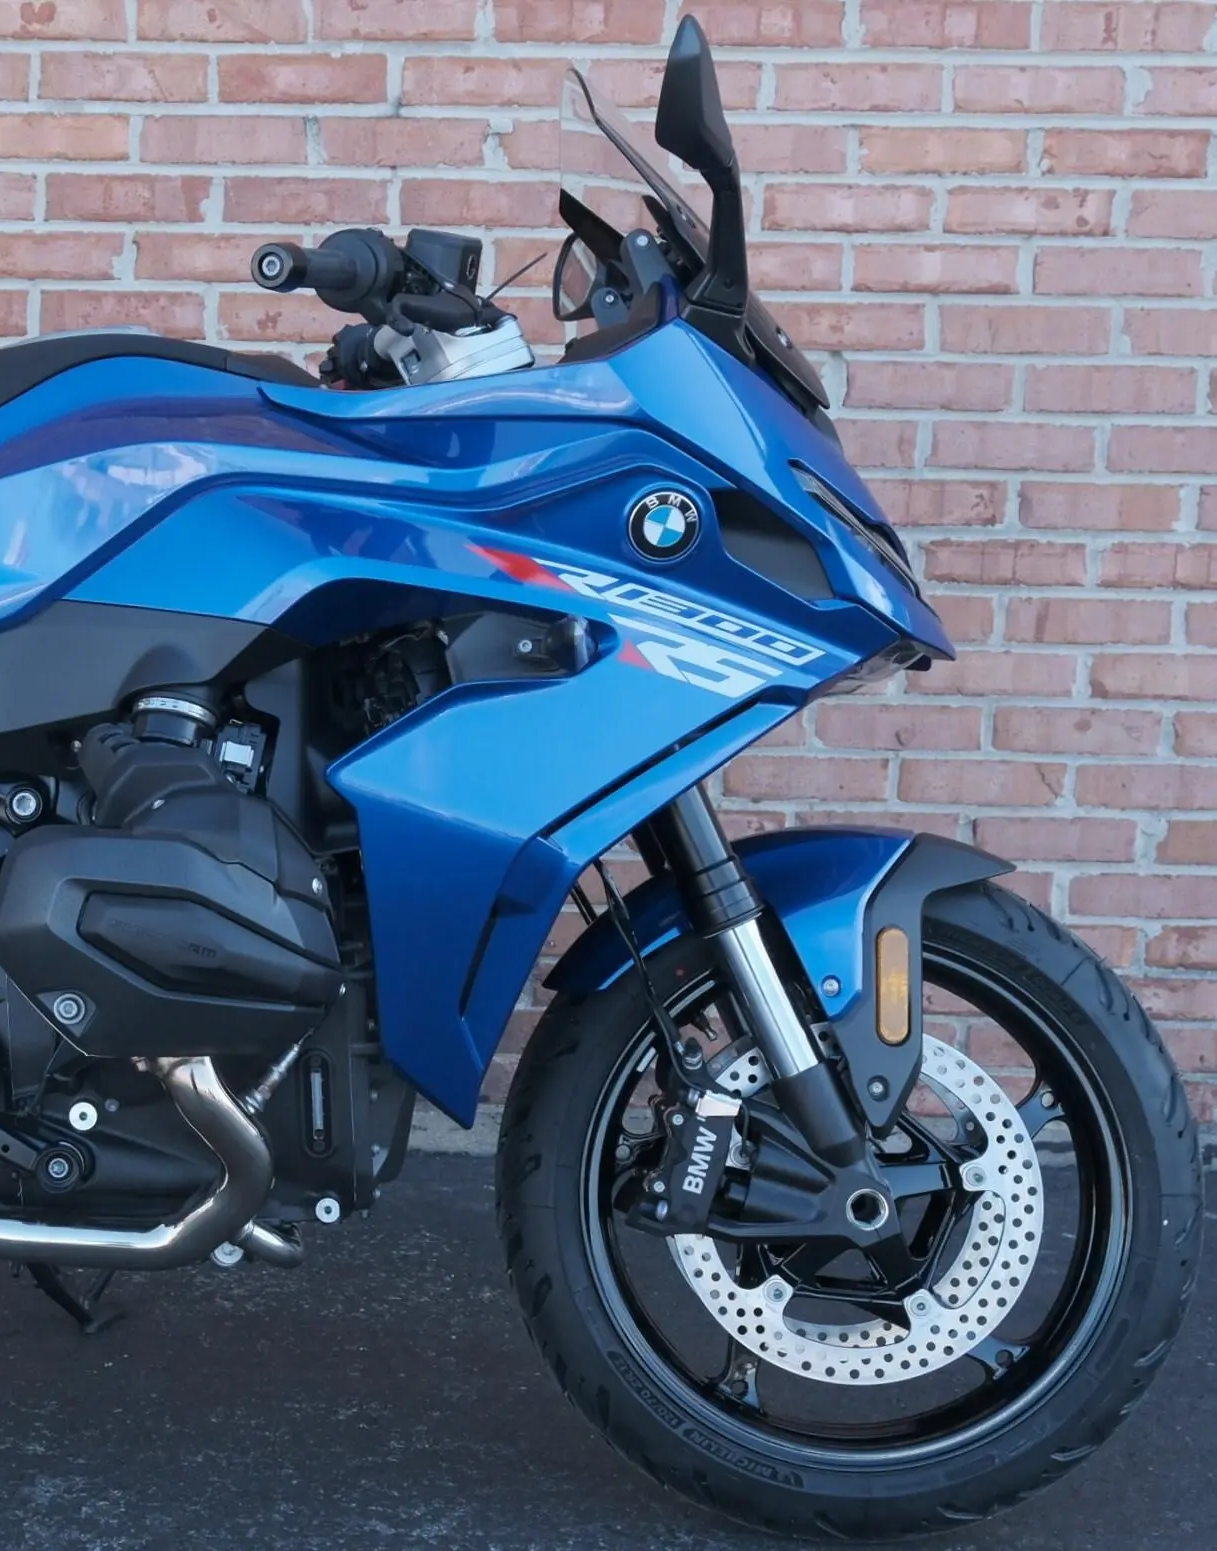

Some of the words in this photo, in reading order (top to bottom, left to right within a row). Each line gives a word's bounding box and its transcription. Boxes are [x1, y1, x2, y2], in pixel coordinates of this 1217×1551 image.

[645, 495, 698, 522] BMW
[609, 612, 784, 699] RS
[683, 1126, 718, 1195] BMW
